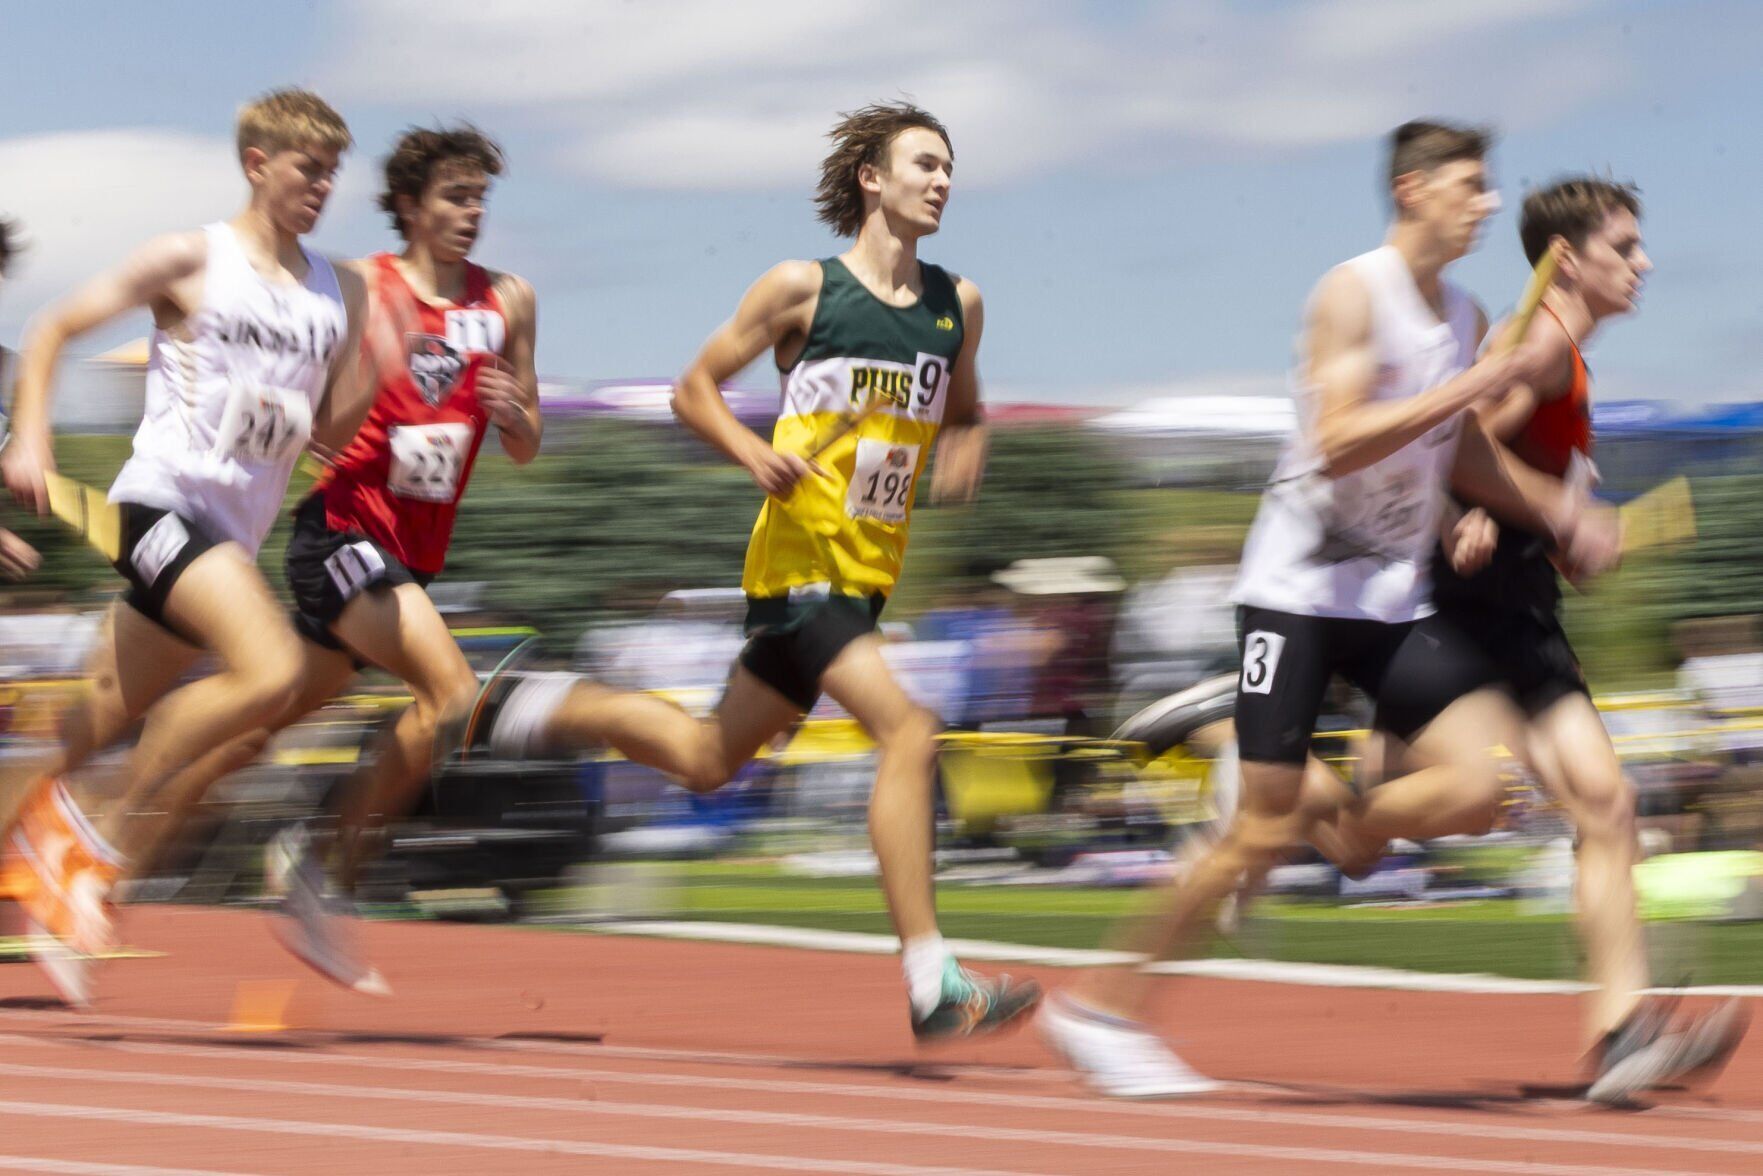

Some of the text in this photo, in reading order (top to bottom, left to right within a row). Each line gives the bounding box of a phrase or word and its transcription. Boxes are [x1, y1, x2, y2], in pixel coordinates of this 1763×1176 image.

[848, 366, 914, 410] PIUS
[917, 359, 942, 406] 9
[331, 545, 372, 588] 11
[1247, 637, 1268, 687] 3
